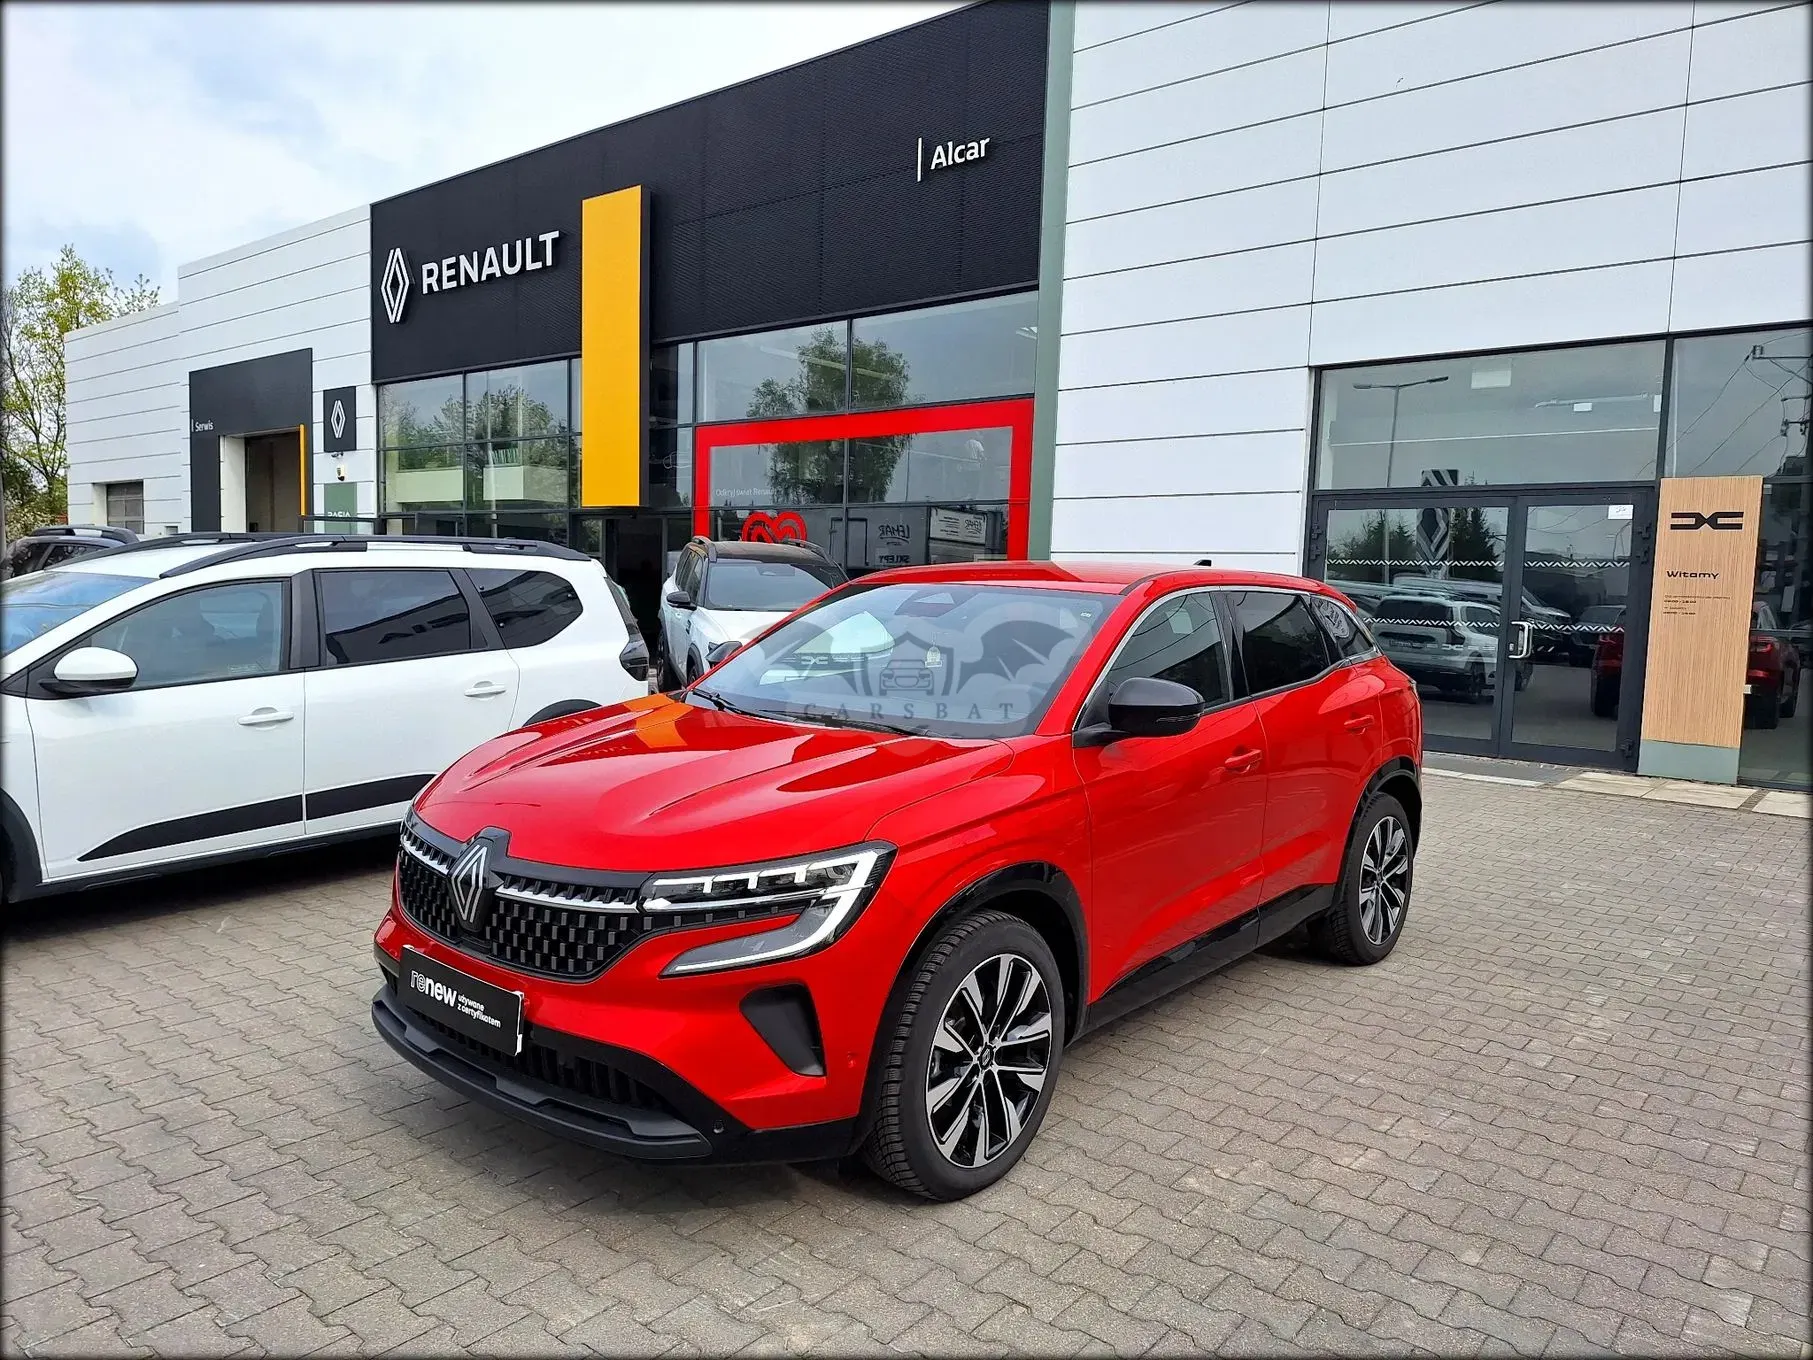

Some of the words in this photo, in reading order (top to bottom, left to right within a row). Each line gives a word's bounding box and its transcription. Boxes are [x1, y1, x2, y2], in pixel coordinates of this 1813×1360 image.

[930, 137, 991, 170] Alcar
[421, 230, 560, 295] RENAULT
[195, 419, 214, 431] Serwis
[1666, 570, 1720, 580] Witamy
[410, 969, 458, 1007] renew
[457, 993, 485, 1012] używane
[461, 1005, 502, 1029] certyfikatem
